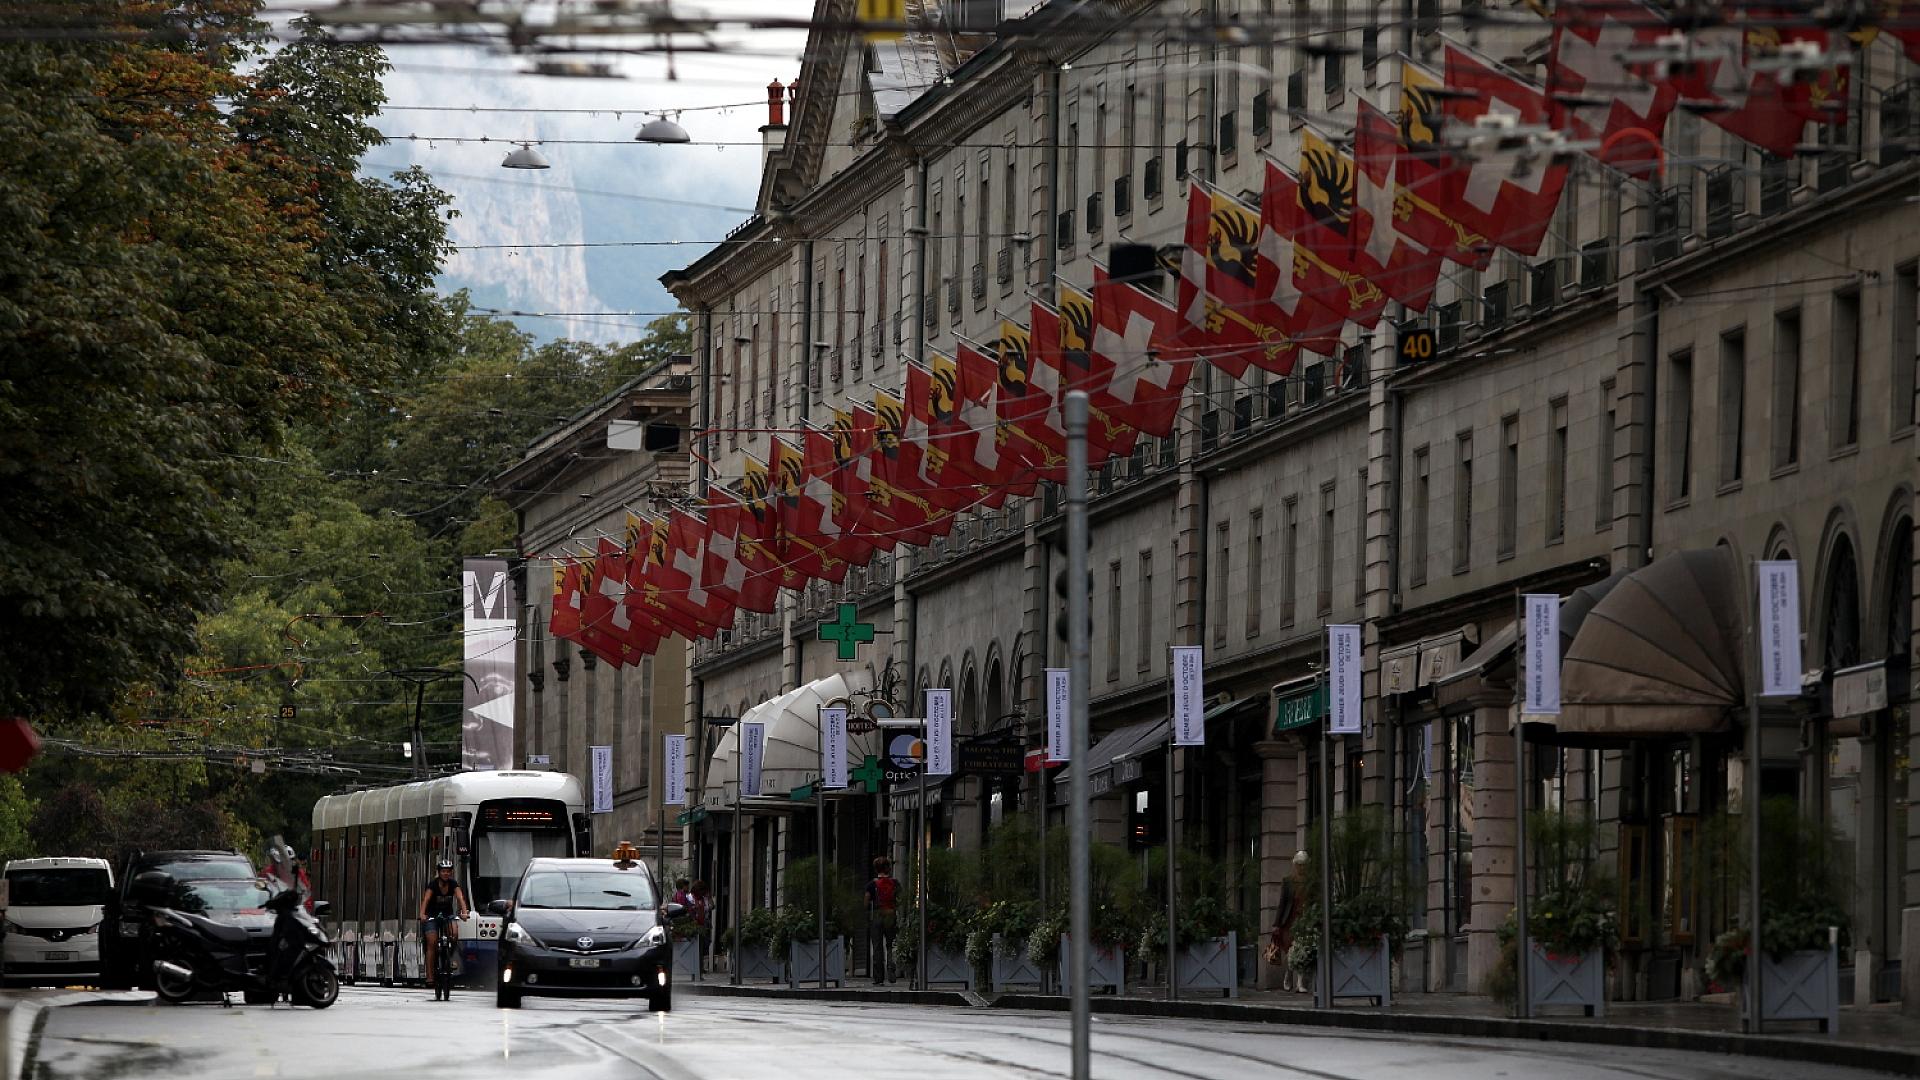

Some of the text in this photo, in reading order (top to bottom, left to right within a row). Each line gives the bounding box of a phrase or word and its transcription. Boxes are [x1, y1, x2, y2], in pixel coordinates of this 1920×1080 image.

[1403, 334, 1432, 359] 40
[1772, 624, 1780, 648] JEUDI
[282, 707, 294, 718] 25
